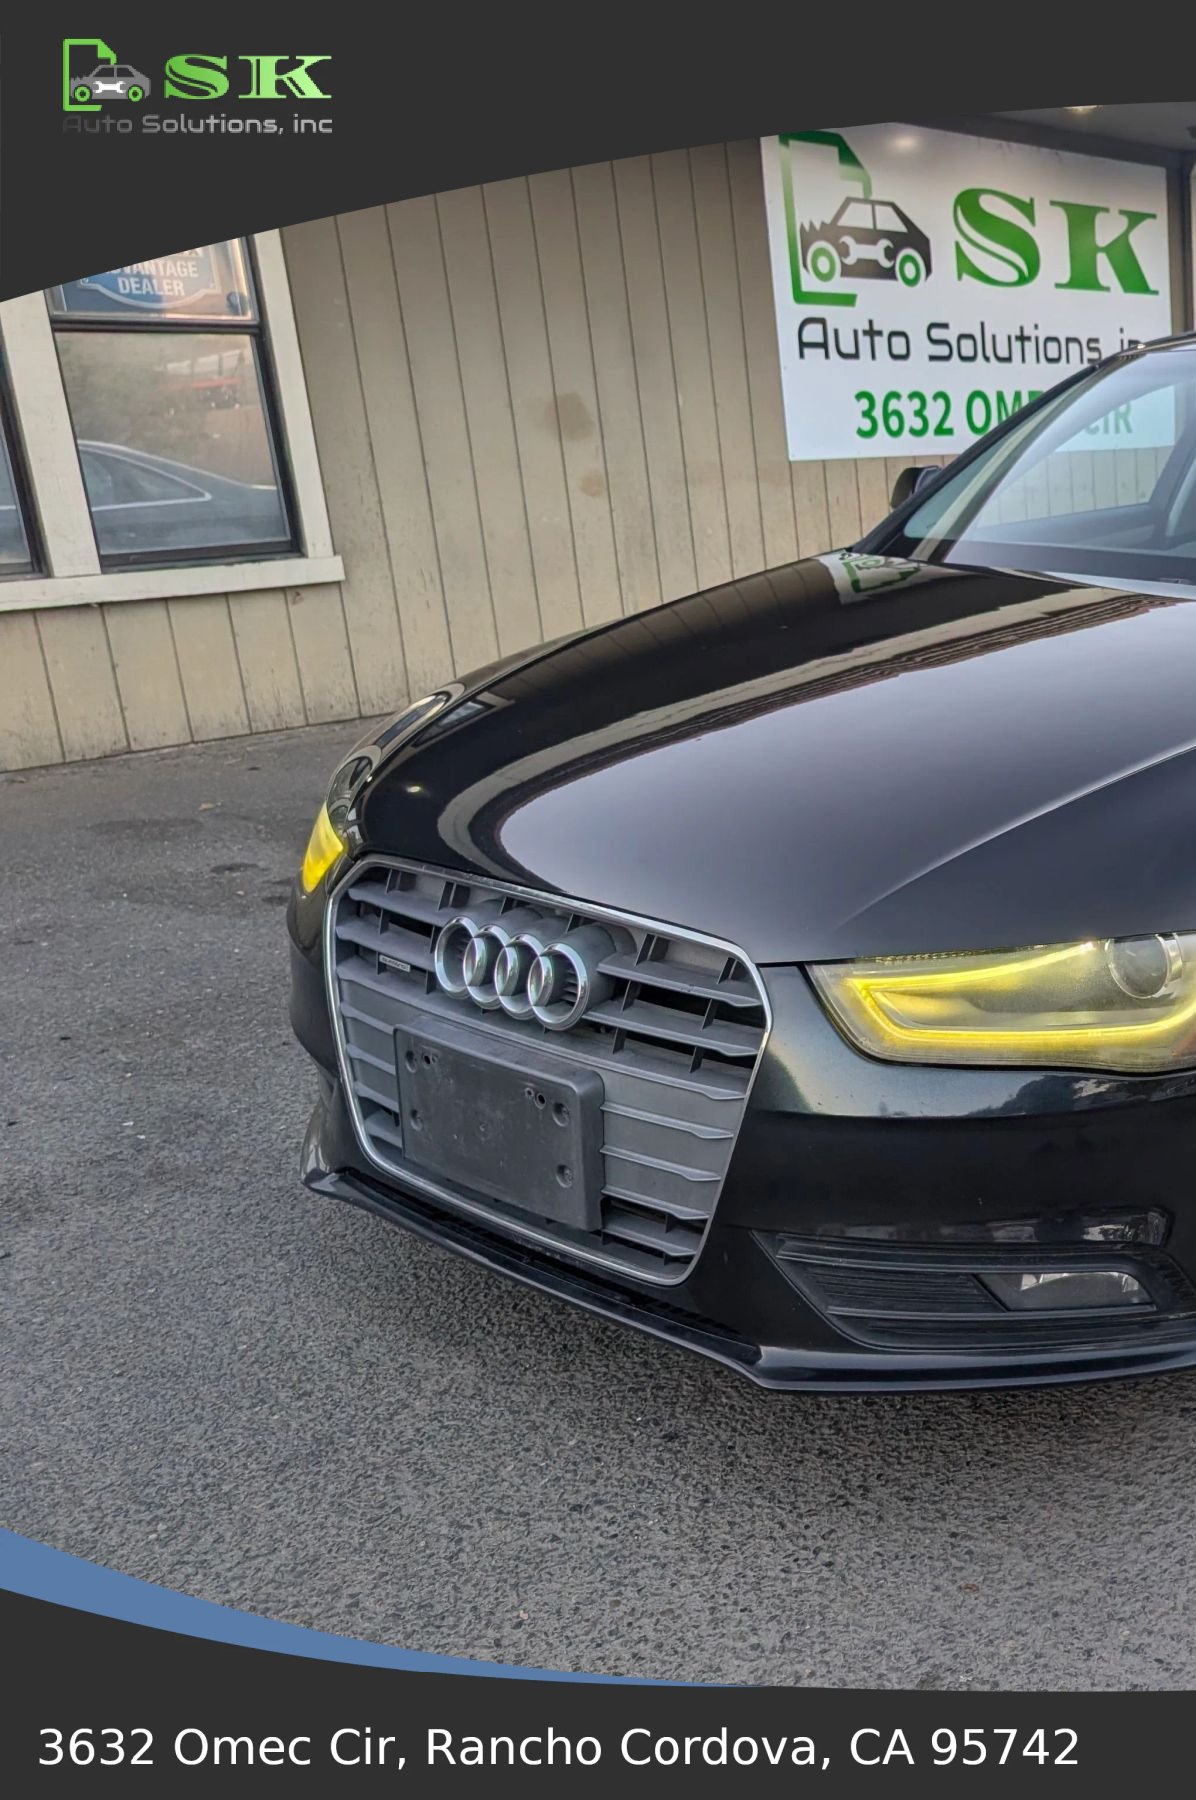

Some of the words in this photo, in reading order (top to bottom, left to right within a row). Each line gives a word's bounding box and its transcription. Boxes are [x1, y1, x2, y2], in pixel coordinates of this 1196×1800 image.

[953, 187, 1160, 295] SK
[106, 259, 200, 278] VANTAGE
[117, 277, 185, 296] DEALER
[797, 317, 911, 361] Auto
[926, 321, 1103, 365] Solutions
[854, 390, 954, 439] 3632
[966, 389, 1044, 435] OM
